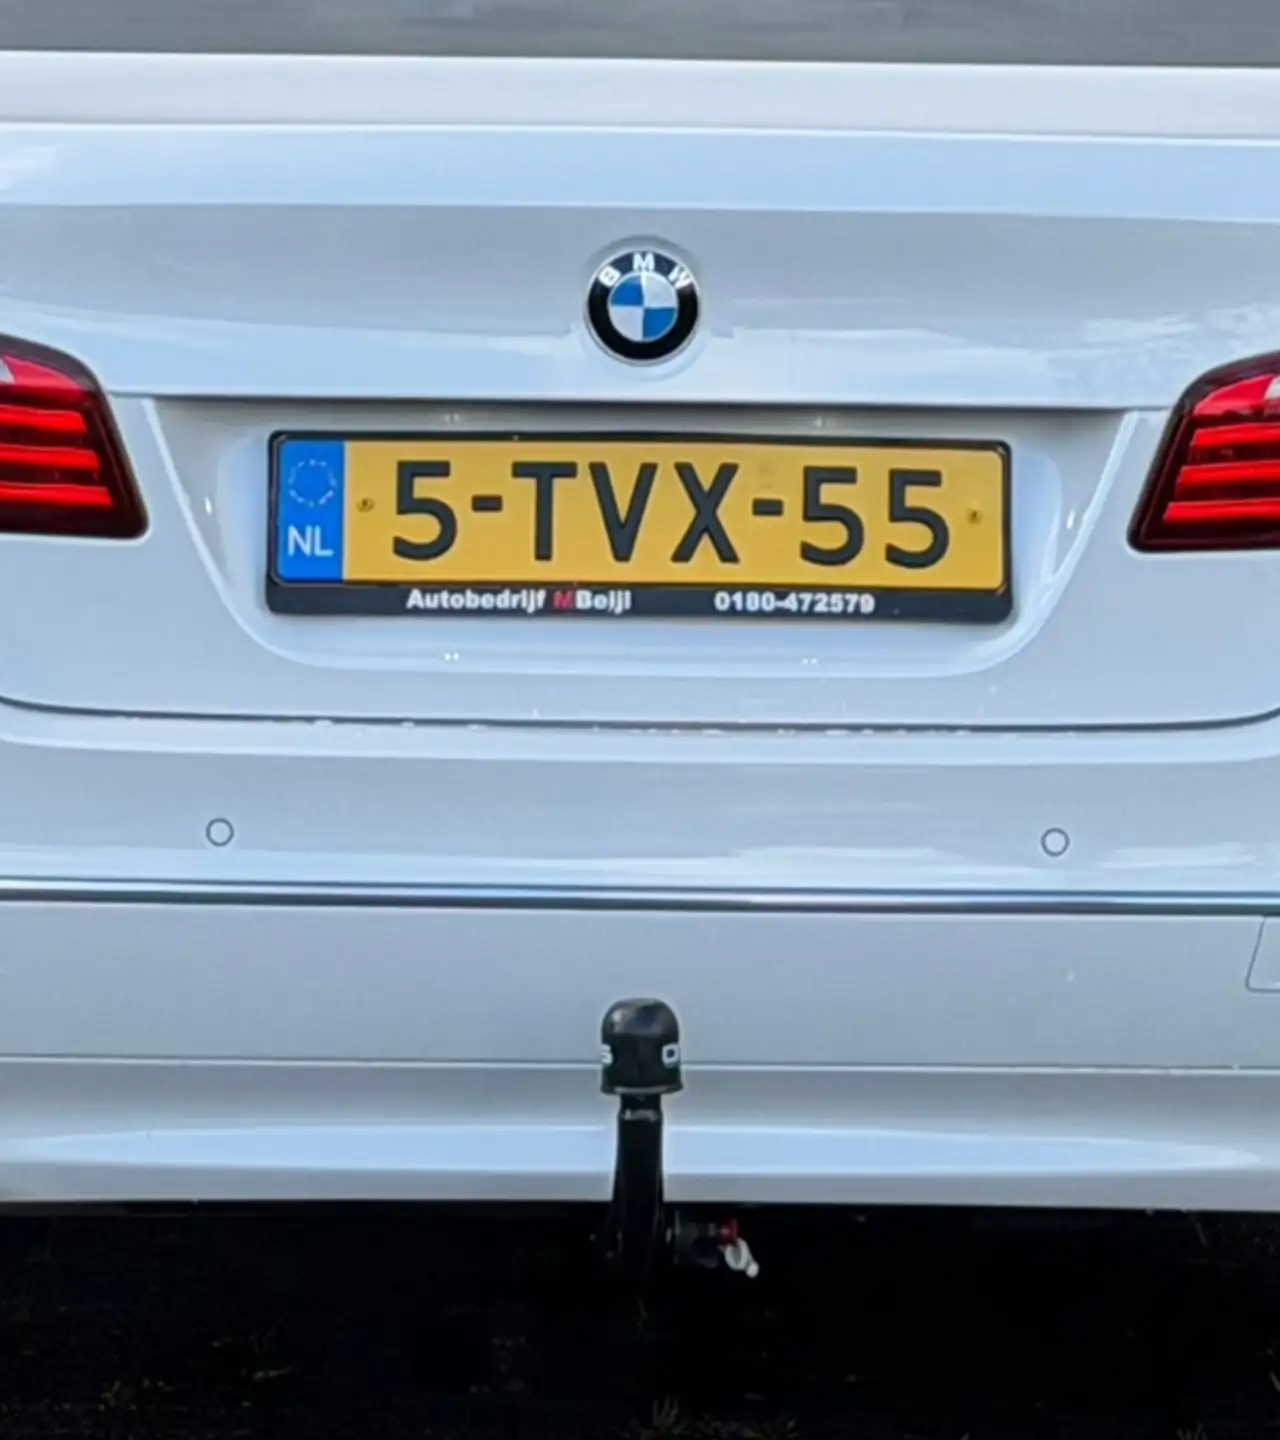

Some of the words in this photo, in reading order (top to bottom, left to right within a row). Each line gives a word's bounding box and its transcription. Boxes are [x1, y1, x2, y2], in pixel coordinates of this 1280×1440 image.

[598, 251, 693, 290] BMW
[391, 459, 951, 570] 5-TVX-55
[287, 524, 334, 557] NL
[406, 588, 547, 614] Autobedrijf
[714, 590, 876, 614] 0180-472579
